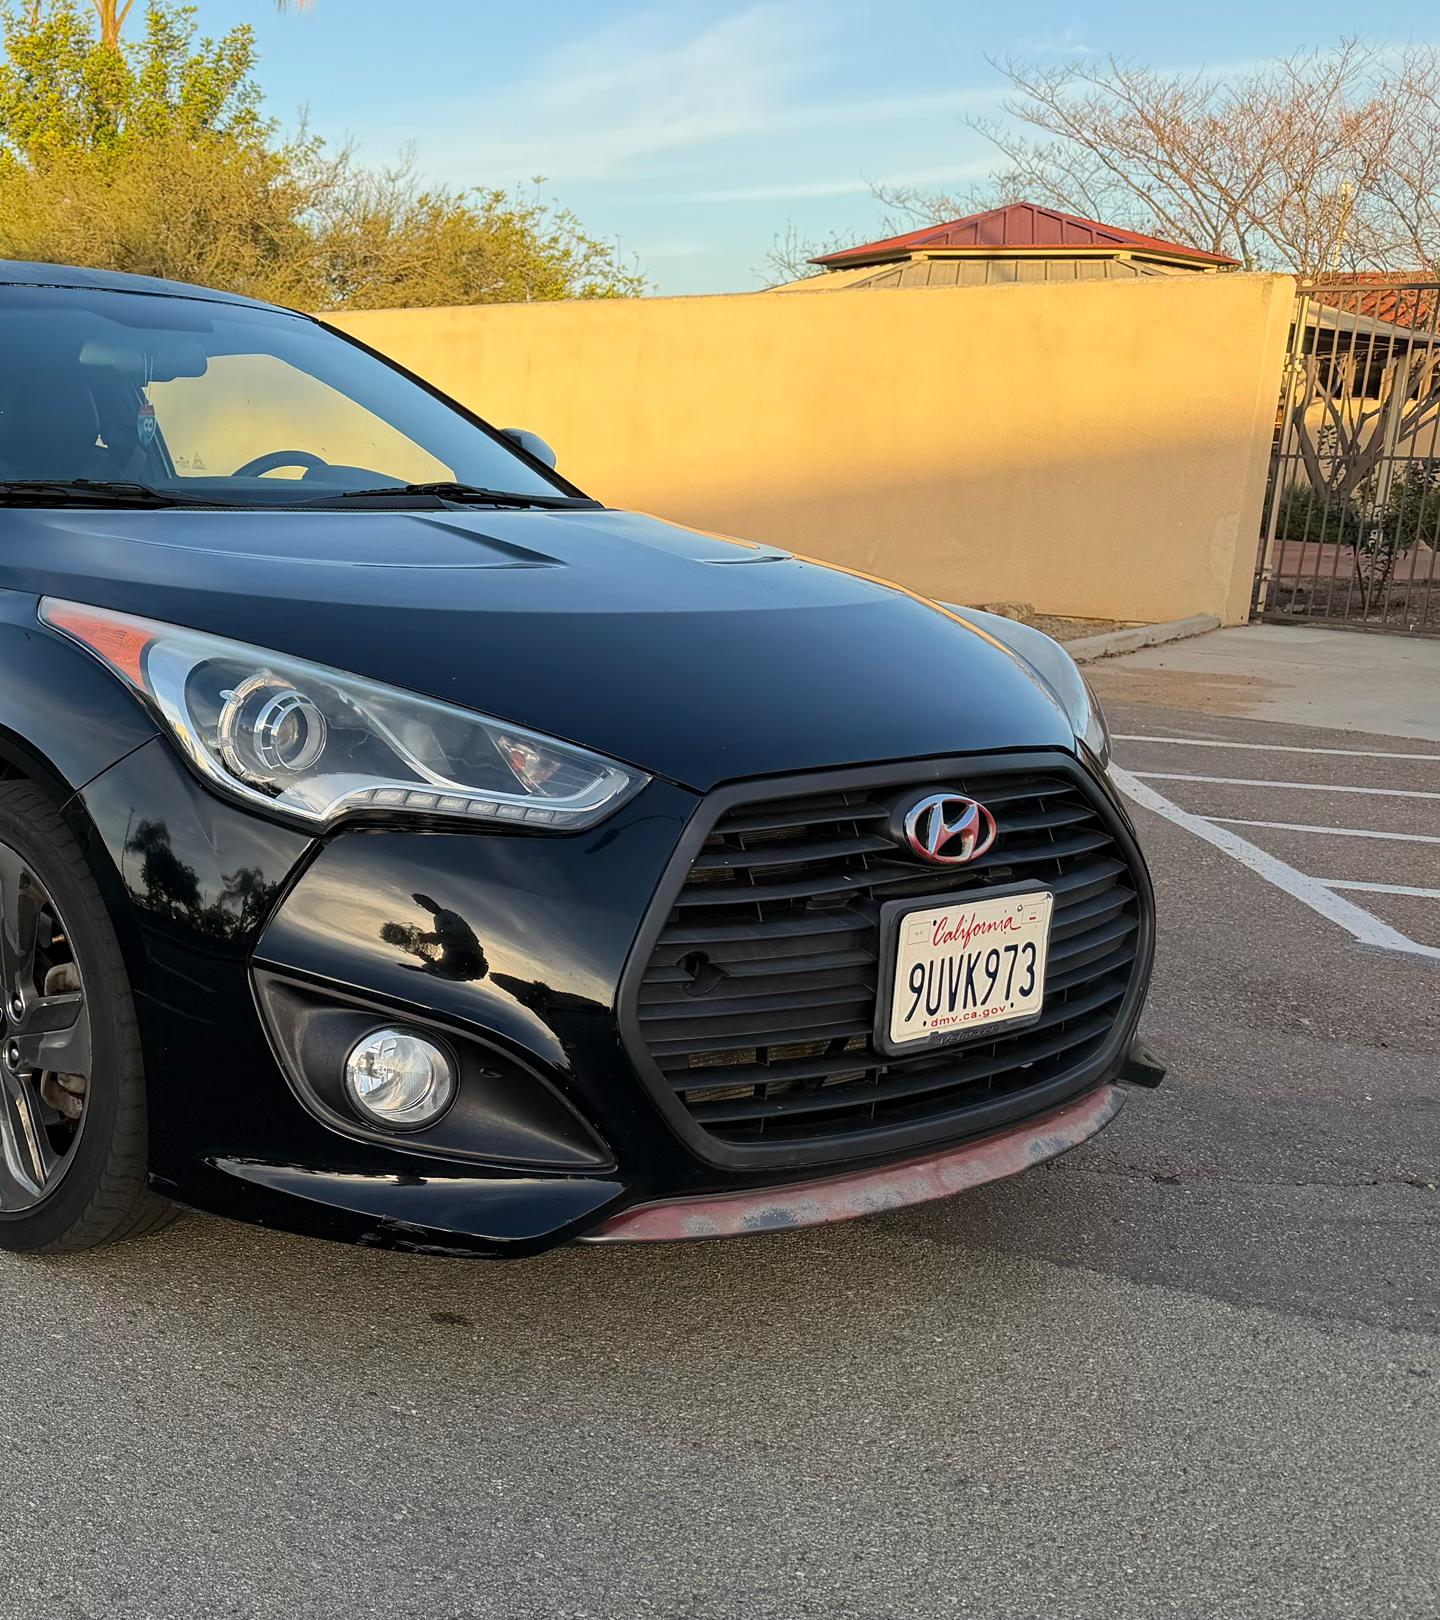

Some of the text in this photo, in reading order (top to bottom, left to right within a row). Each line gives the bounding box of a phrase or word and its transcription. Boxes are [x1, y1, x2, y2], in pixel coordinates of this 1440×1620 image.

[932, 912, 1022, 950] California
[904, 941, 1037, 1023] 9UVK973
[930, 1004, 1007, 1028] dmv.ca.gov
